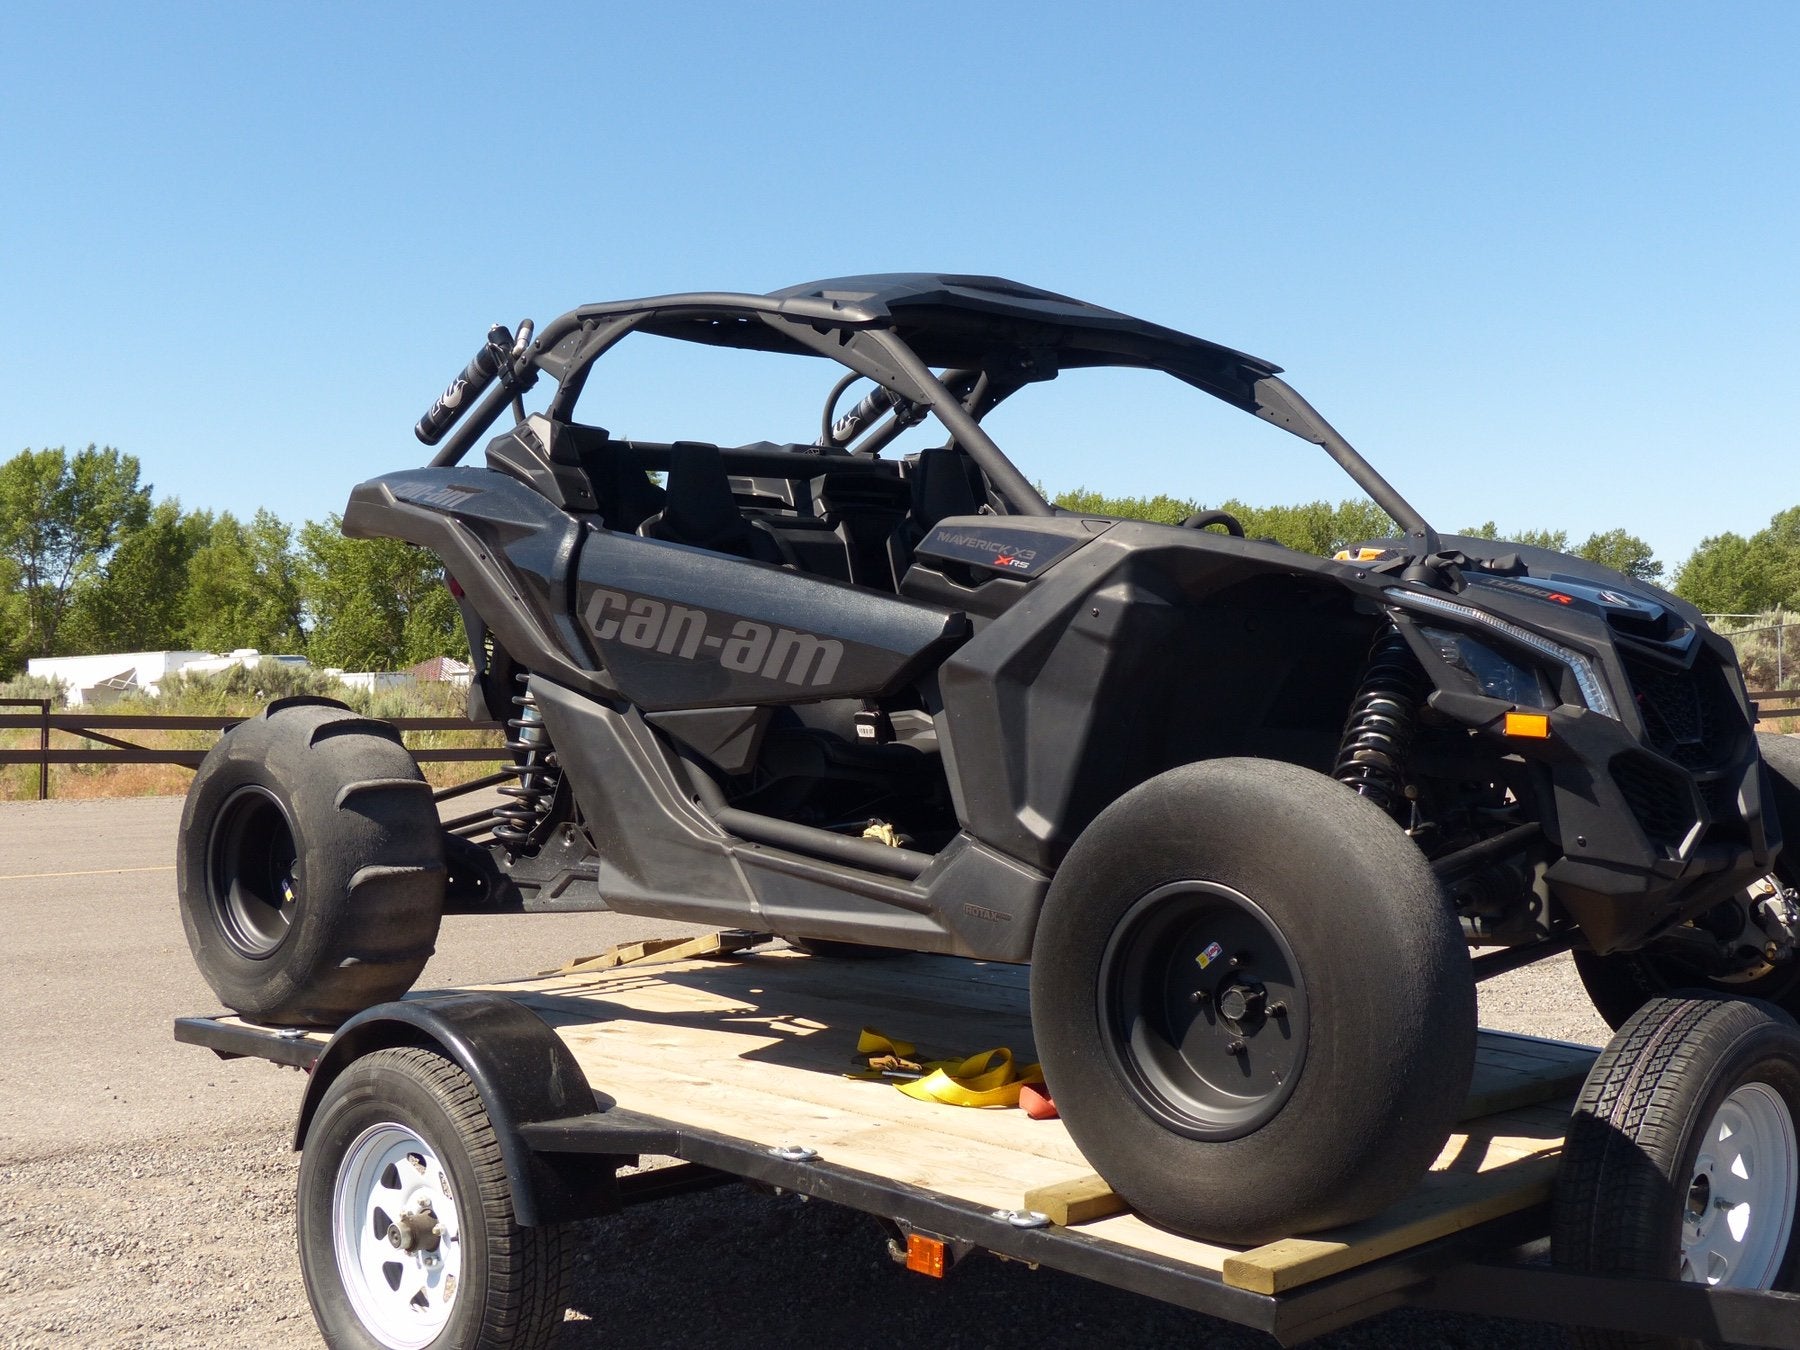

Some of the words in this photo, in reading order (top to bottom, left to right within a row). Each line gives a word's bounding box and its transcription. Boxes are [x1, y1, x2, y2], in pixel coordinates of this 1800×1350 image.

[937, 531, 1012, 556] MAVERICK
[1010, 546, 1037, 560] X3
[584, 588, 844, 686] can-am
